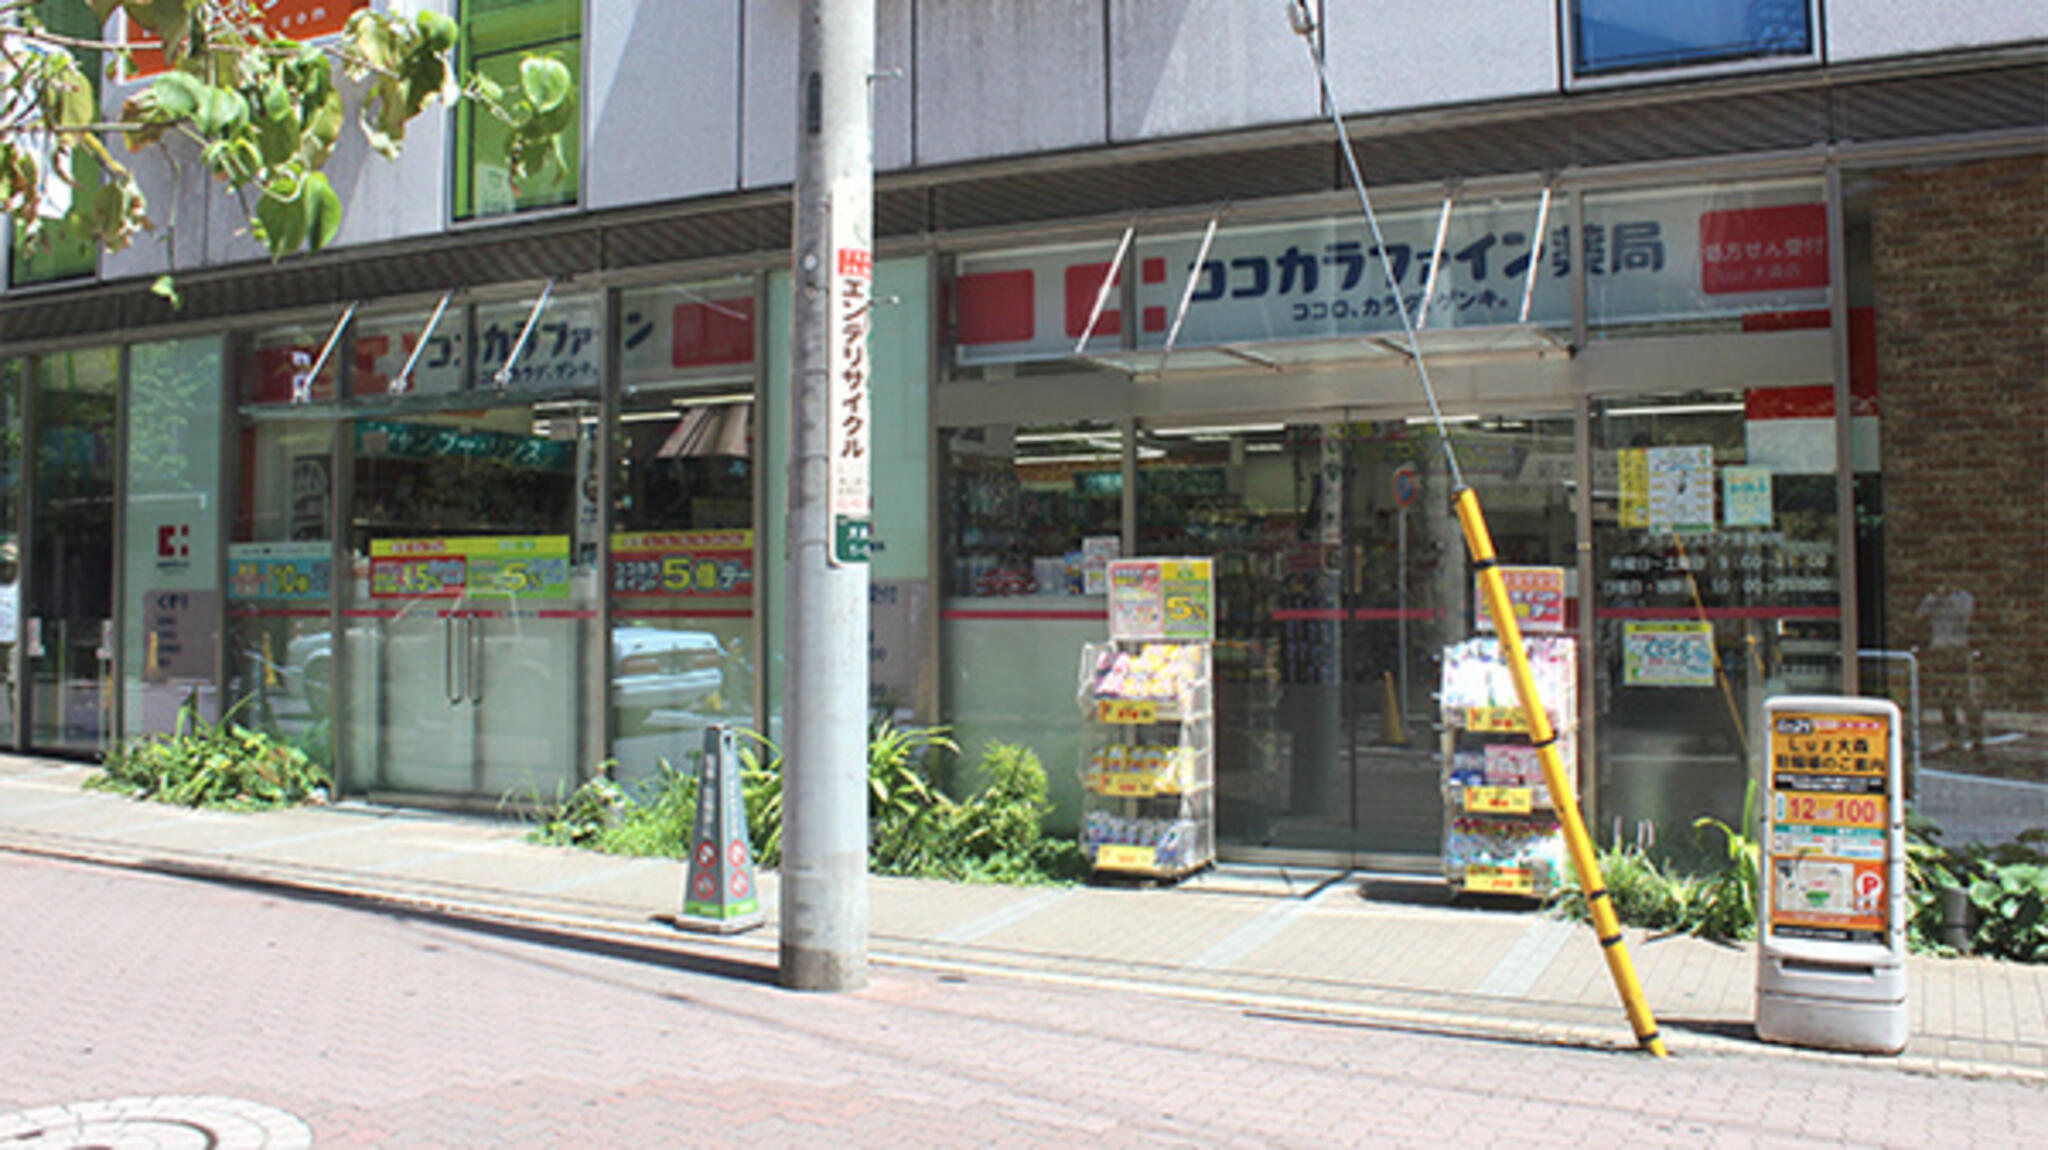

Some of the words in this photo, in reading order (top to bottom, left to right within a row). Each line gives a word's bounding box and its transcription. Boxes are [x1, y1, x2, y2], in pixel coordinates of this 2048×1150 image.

[1186, 220, 1664, 303] ココカラファイン薬局
